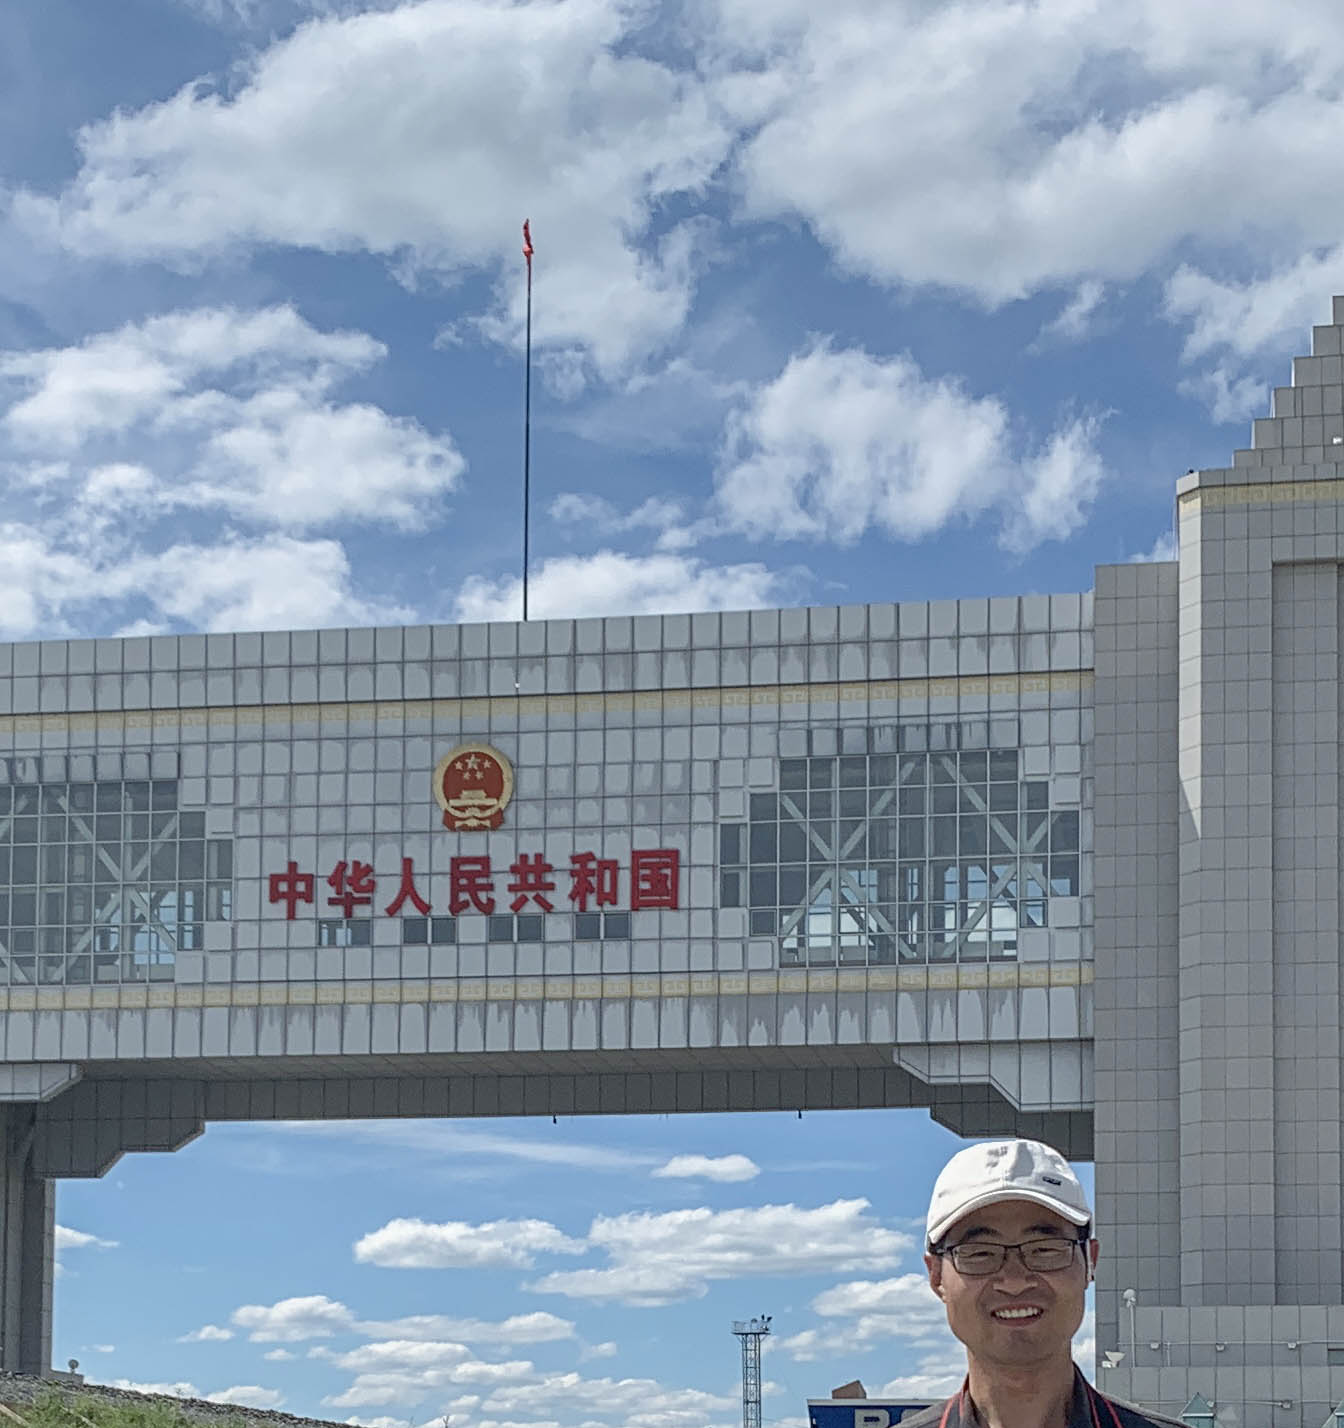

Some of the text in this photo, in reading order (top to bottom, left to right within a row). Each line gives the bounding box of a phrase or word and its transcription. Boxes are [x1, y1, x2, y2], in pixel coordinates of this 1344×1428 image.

[269, 848, 680, 921] 中华人民共和国
